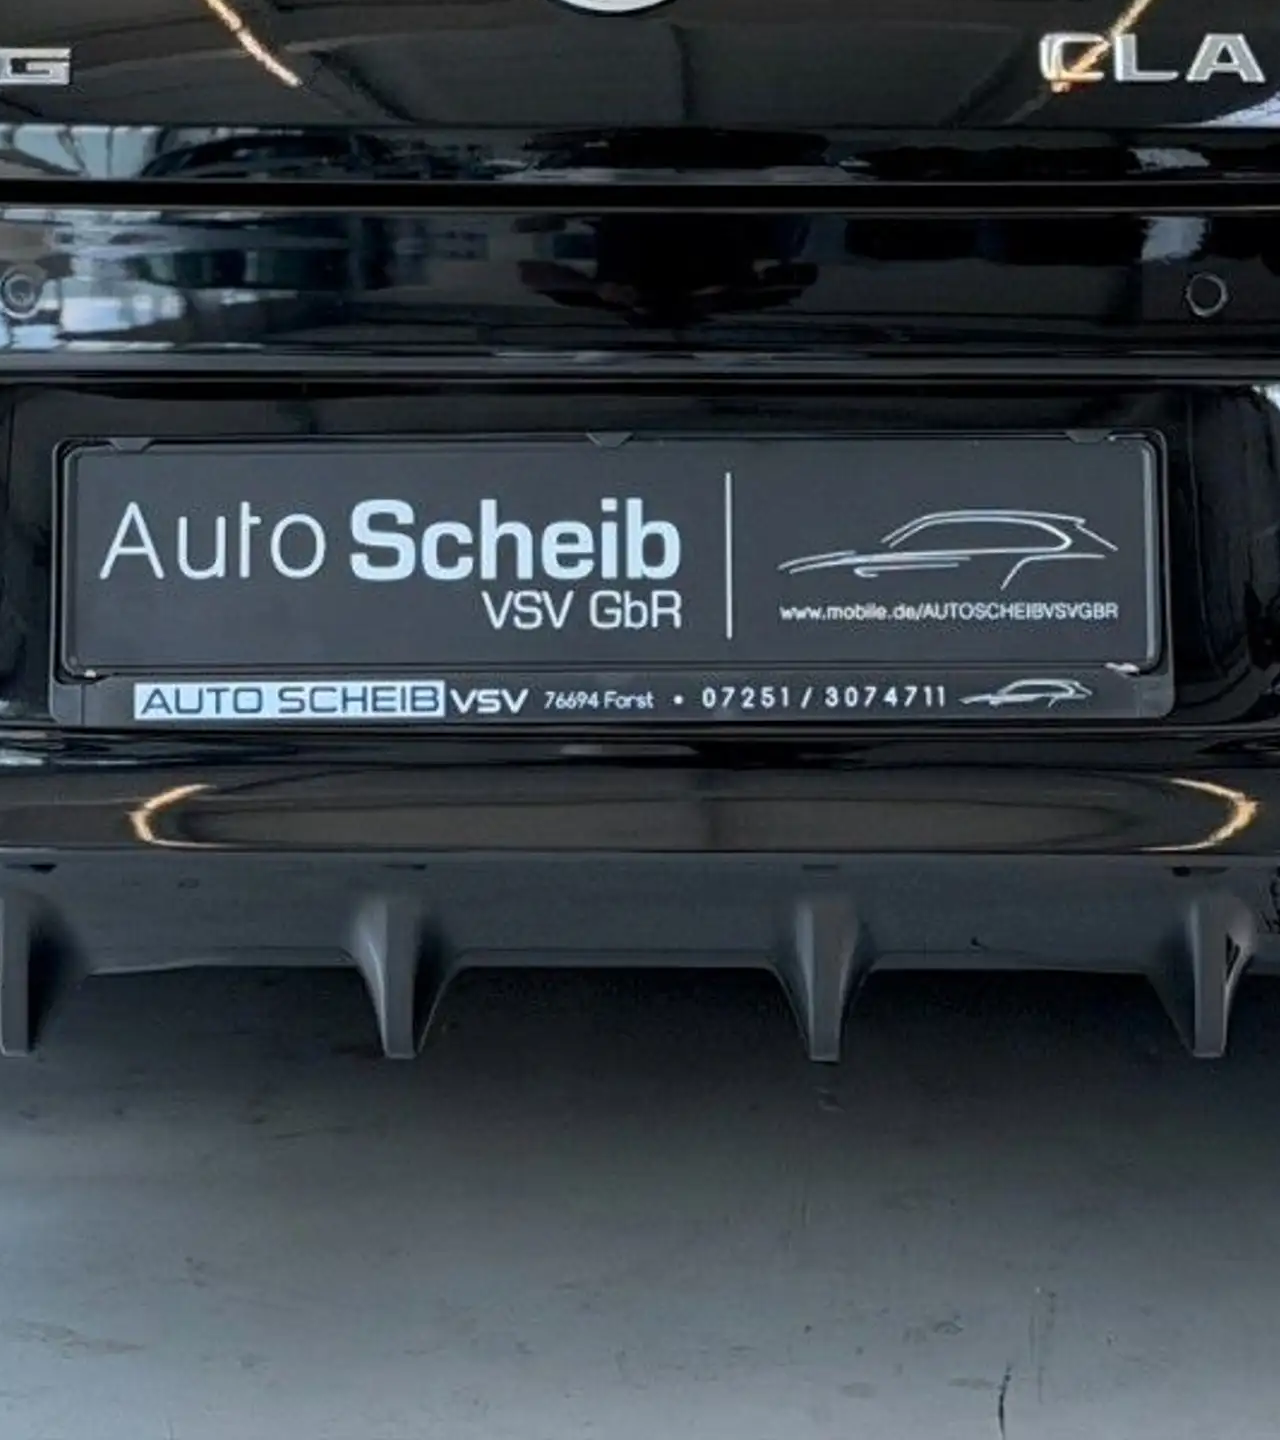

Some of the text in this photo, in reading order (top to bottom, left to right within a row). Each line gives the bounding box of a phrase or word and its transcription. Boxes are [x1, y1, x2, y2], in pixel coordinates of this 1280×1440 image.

[1039, 32, 1266, 84] CLA
[99, 498, 683, 582] Auto Scheib
[481, 590, 683, 630] VSV GbR
[779, 601, 1119, 622] www.mobile.de/AUTOSCHEIBVSVGBR
[140, 687, 264, 716] AUTO
[277, 685, 441, 715] SCHEIB
[450, 687, 530, 714] VSV
[543, 690, 599, 710] 76694
[701, 687, 791, 709] 07251
[824, 687, 947, 709] 3074711
